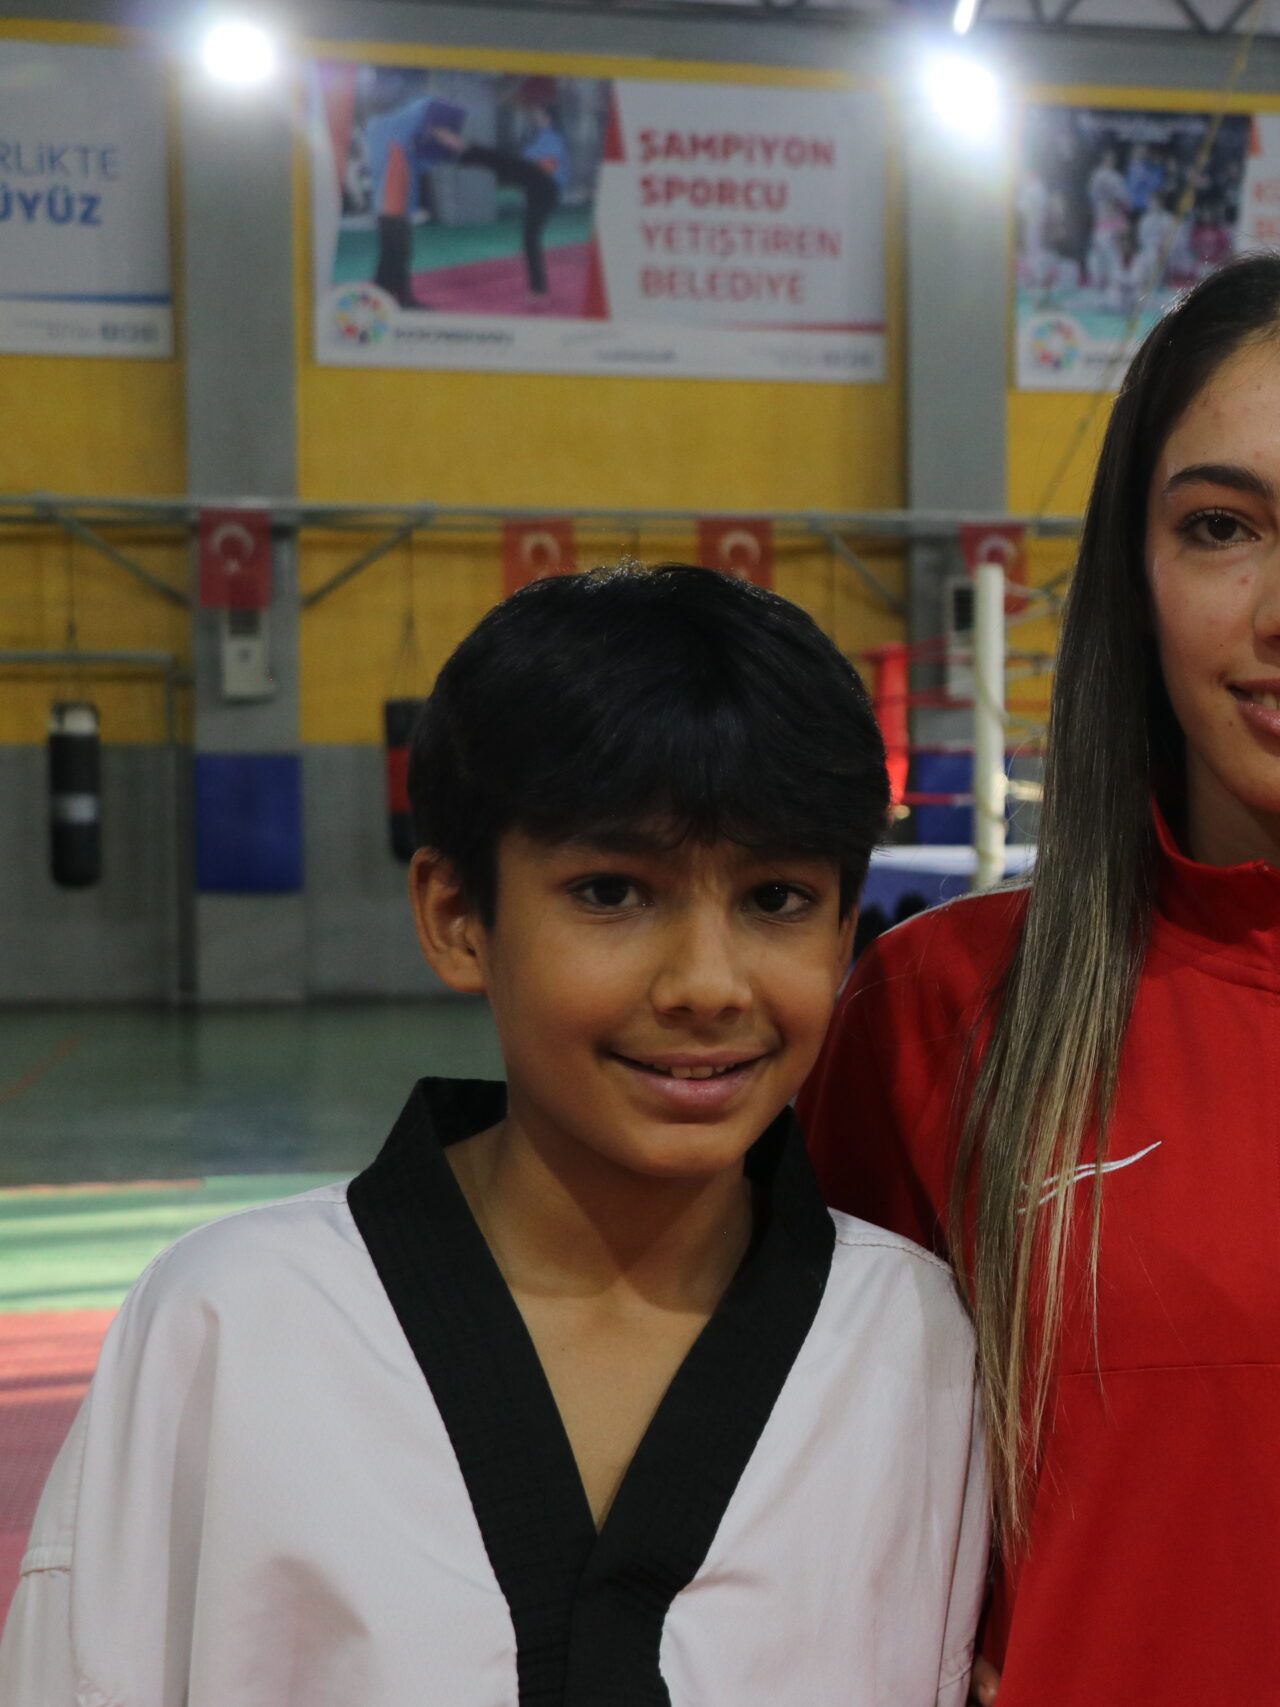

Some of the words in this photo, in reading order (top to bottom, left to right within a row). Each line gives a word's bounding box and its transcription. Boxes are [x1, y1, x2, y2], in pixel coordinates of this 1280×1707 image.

[639, 129, 836, 169] ŞAMPİYON
[639, 174, 789, 212] SPORCU
[639, 265, 806, 304] BELEDİYE
